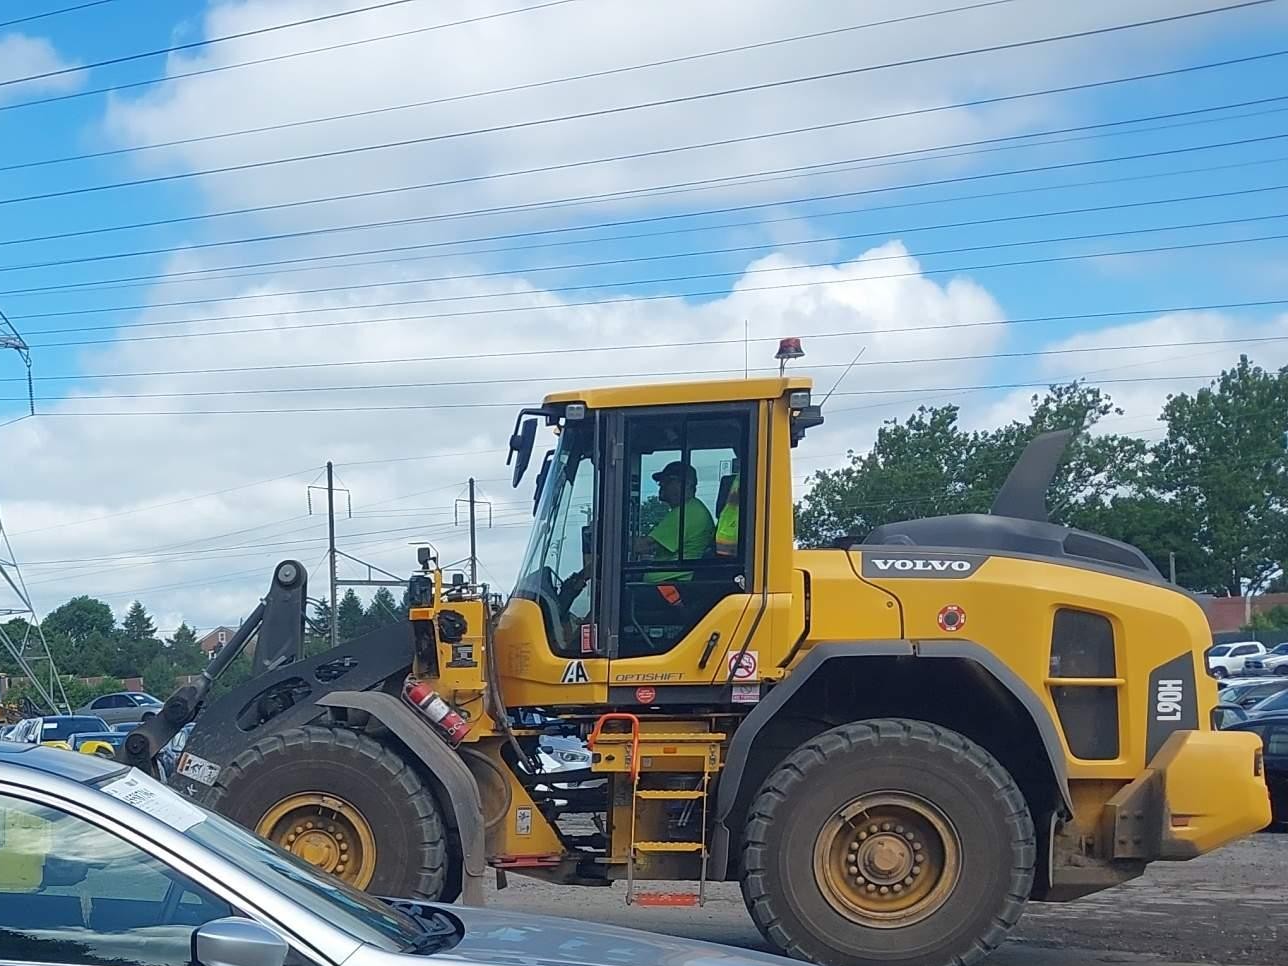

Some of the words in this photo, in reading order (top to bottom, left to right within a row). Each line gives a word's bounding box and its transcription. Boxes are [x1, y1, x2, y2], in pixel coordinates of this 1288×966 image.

[871, 559, 971, 571] VOLVO
[615, 671, 686, 682] OPTISHIFT
[1156, 679, 1183, 721] L90H
